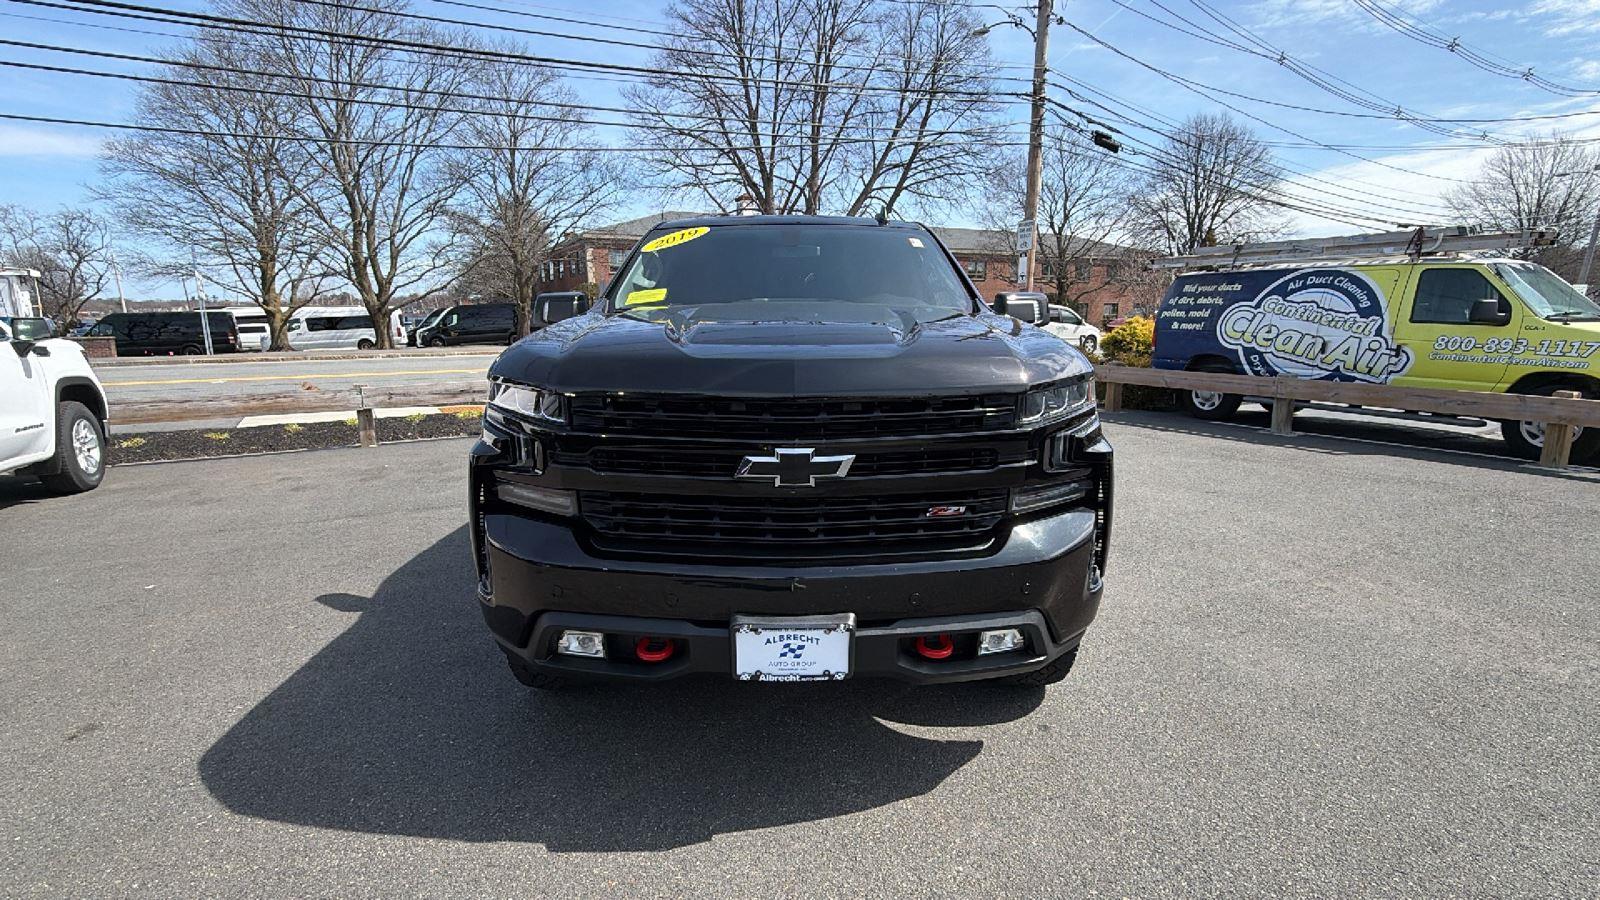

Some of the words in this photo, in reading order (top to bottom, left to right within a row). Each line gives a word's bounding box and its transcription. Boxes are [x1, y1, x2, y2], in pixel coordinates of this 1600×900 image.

[654, 230, 698, 248] 2019
[1183, 283, 1197, 293] Rid
[1196, 285, 1217, 294] your
[1218, 283, 1242, 291] ducts
[1287, 280, 1304, 292] Air
[1306, 276, 1333, 286] Duct
[1334, 277, 1371, 308] Cleaning
[1168, 297, 1179, 305] of
[1178, 296, 1195, 305] dirt,
[1197, 296, 1223, 305] debris,
[1161, 309, 1187, 318] pollen,
[1188, 309, 1211, 317] mold
[1263, 299, 1378, 336] Continental
[1171, 322, 1179, 330] &
[1180, 322, 1205, 330] more!
[1224, 310, 1326, 362] Clean
[1322, 335, 1402, 378] Air
[1434, 336, 1600, 358] 800-893-1117
[1428, 351, 1590, 369] ContinentalCleanAir.com
[764, 634, 821, 645] ALBRECHT
[759, 673, 801, 681] Albrecht
